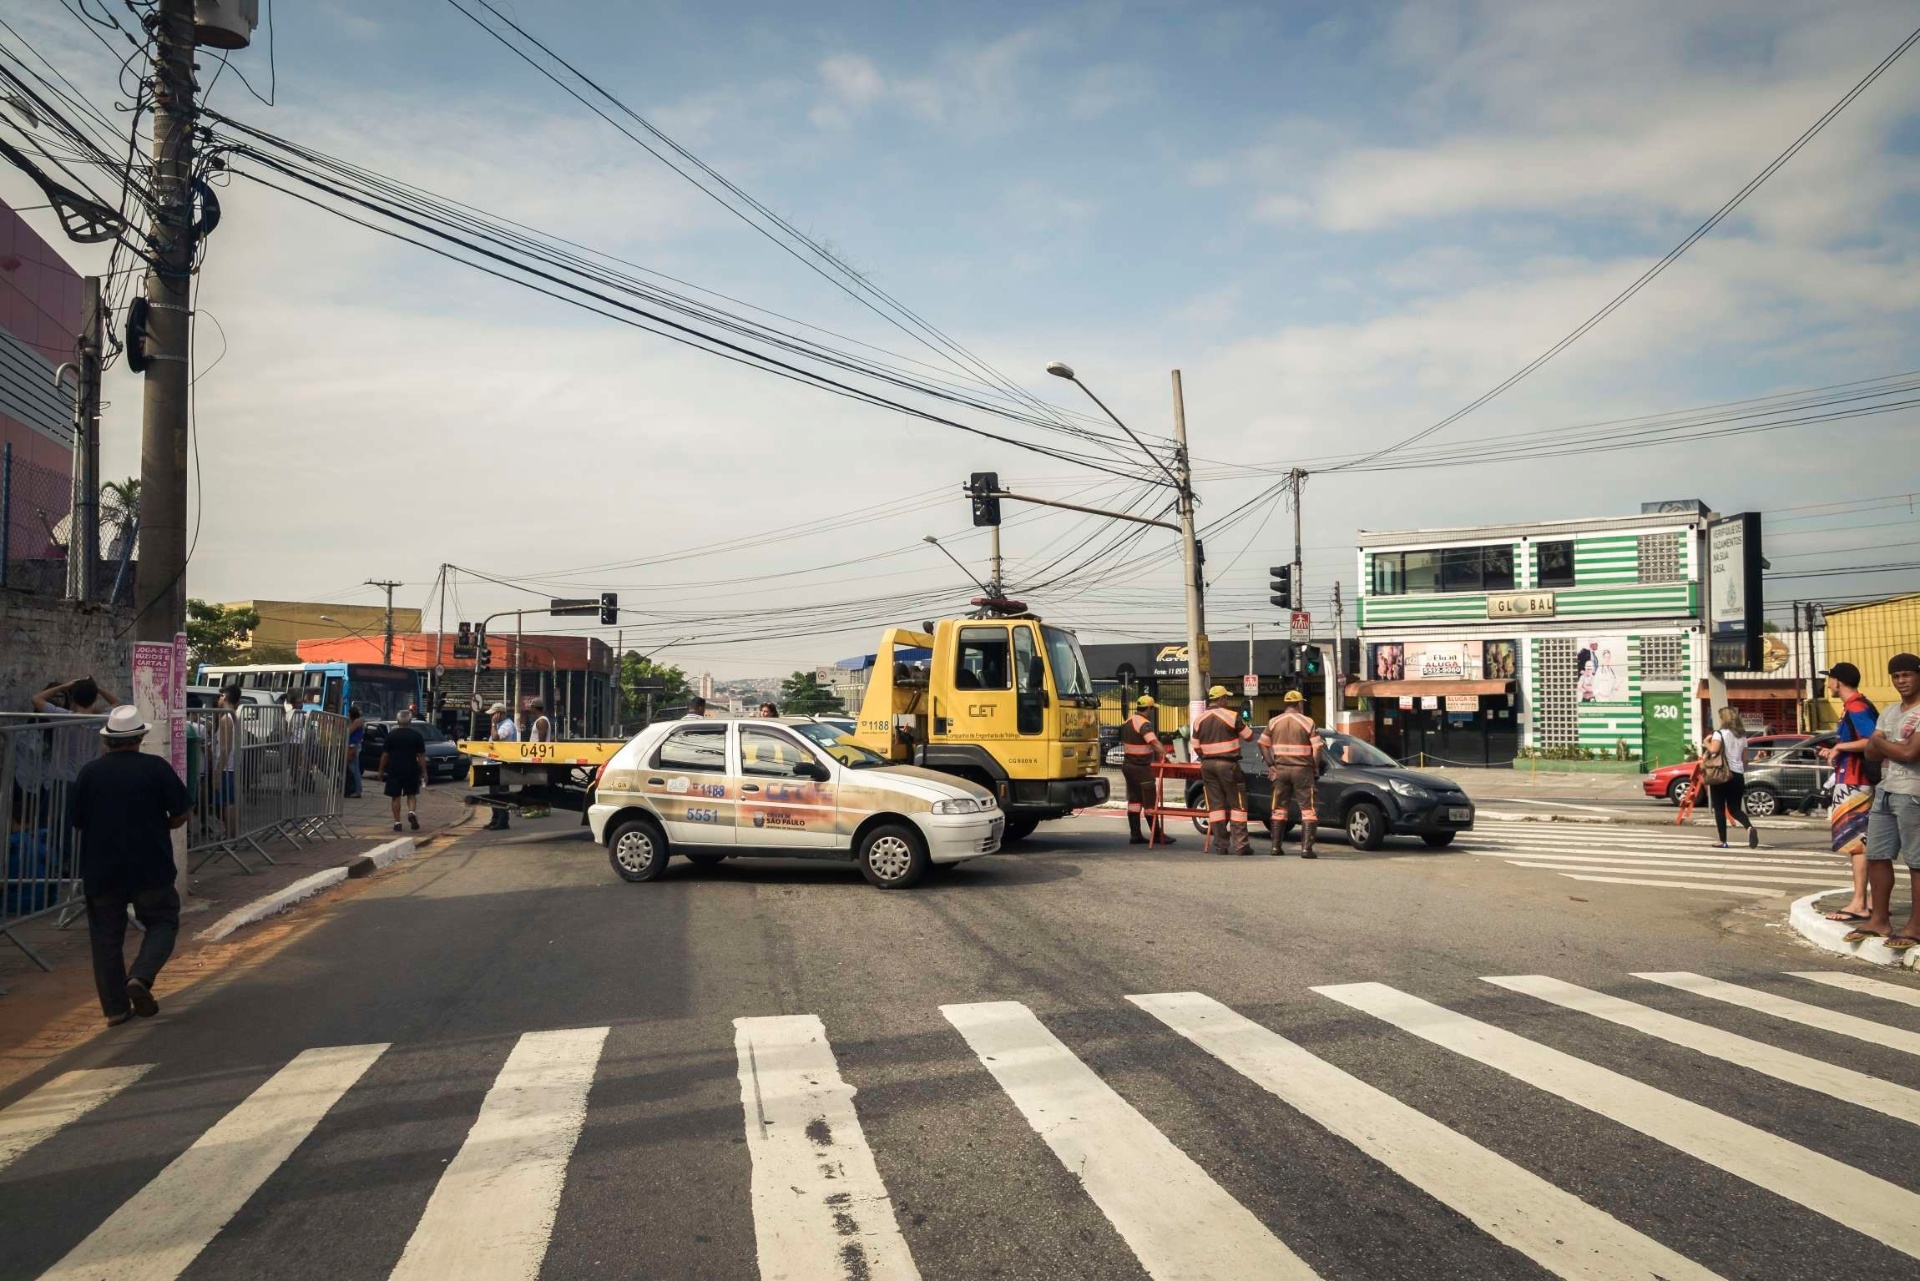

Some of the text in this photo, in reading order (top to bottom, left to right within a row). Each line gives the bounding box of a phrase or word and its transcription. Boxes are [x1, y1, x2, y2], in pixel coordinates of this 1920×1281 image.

[968, 704, 997, 717] CET
[1653, 704, 1678, 719] 230
[869, 720, 889, 731] 1188
[520, 743, 555, 758] 0491
[700, 783, 726, 797] 1188
[686, 806, 719, 822] 5551
[782, 818, 806, 826] PAULO
